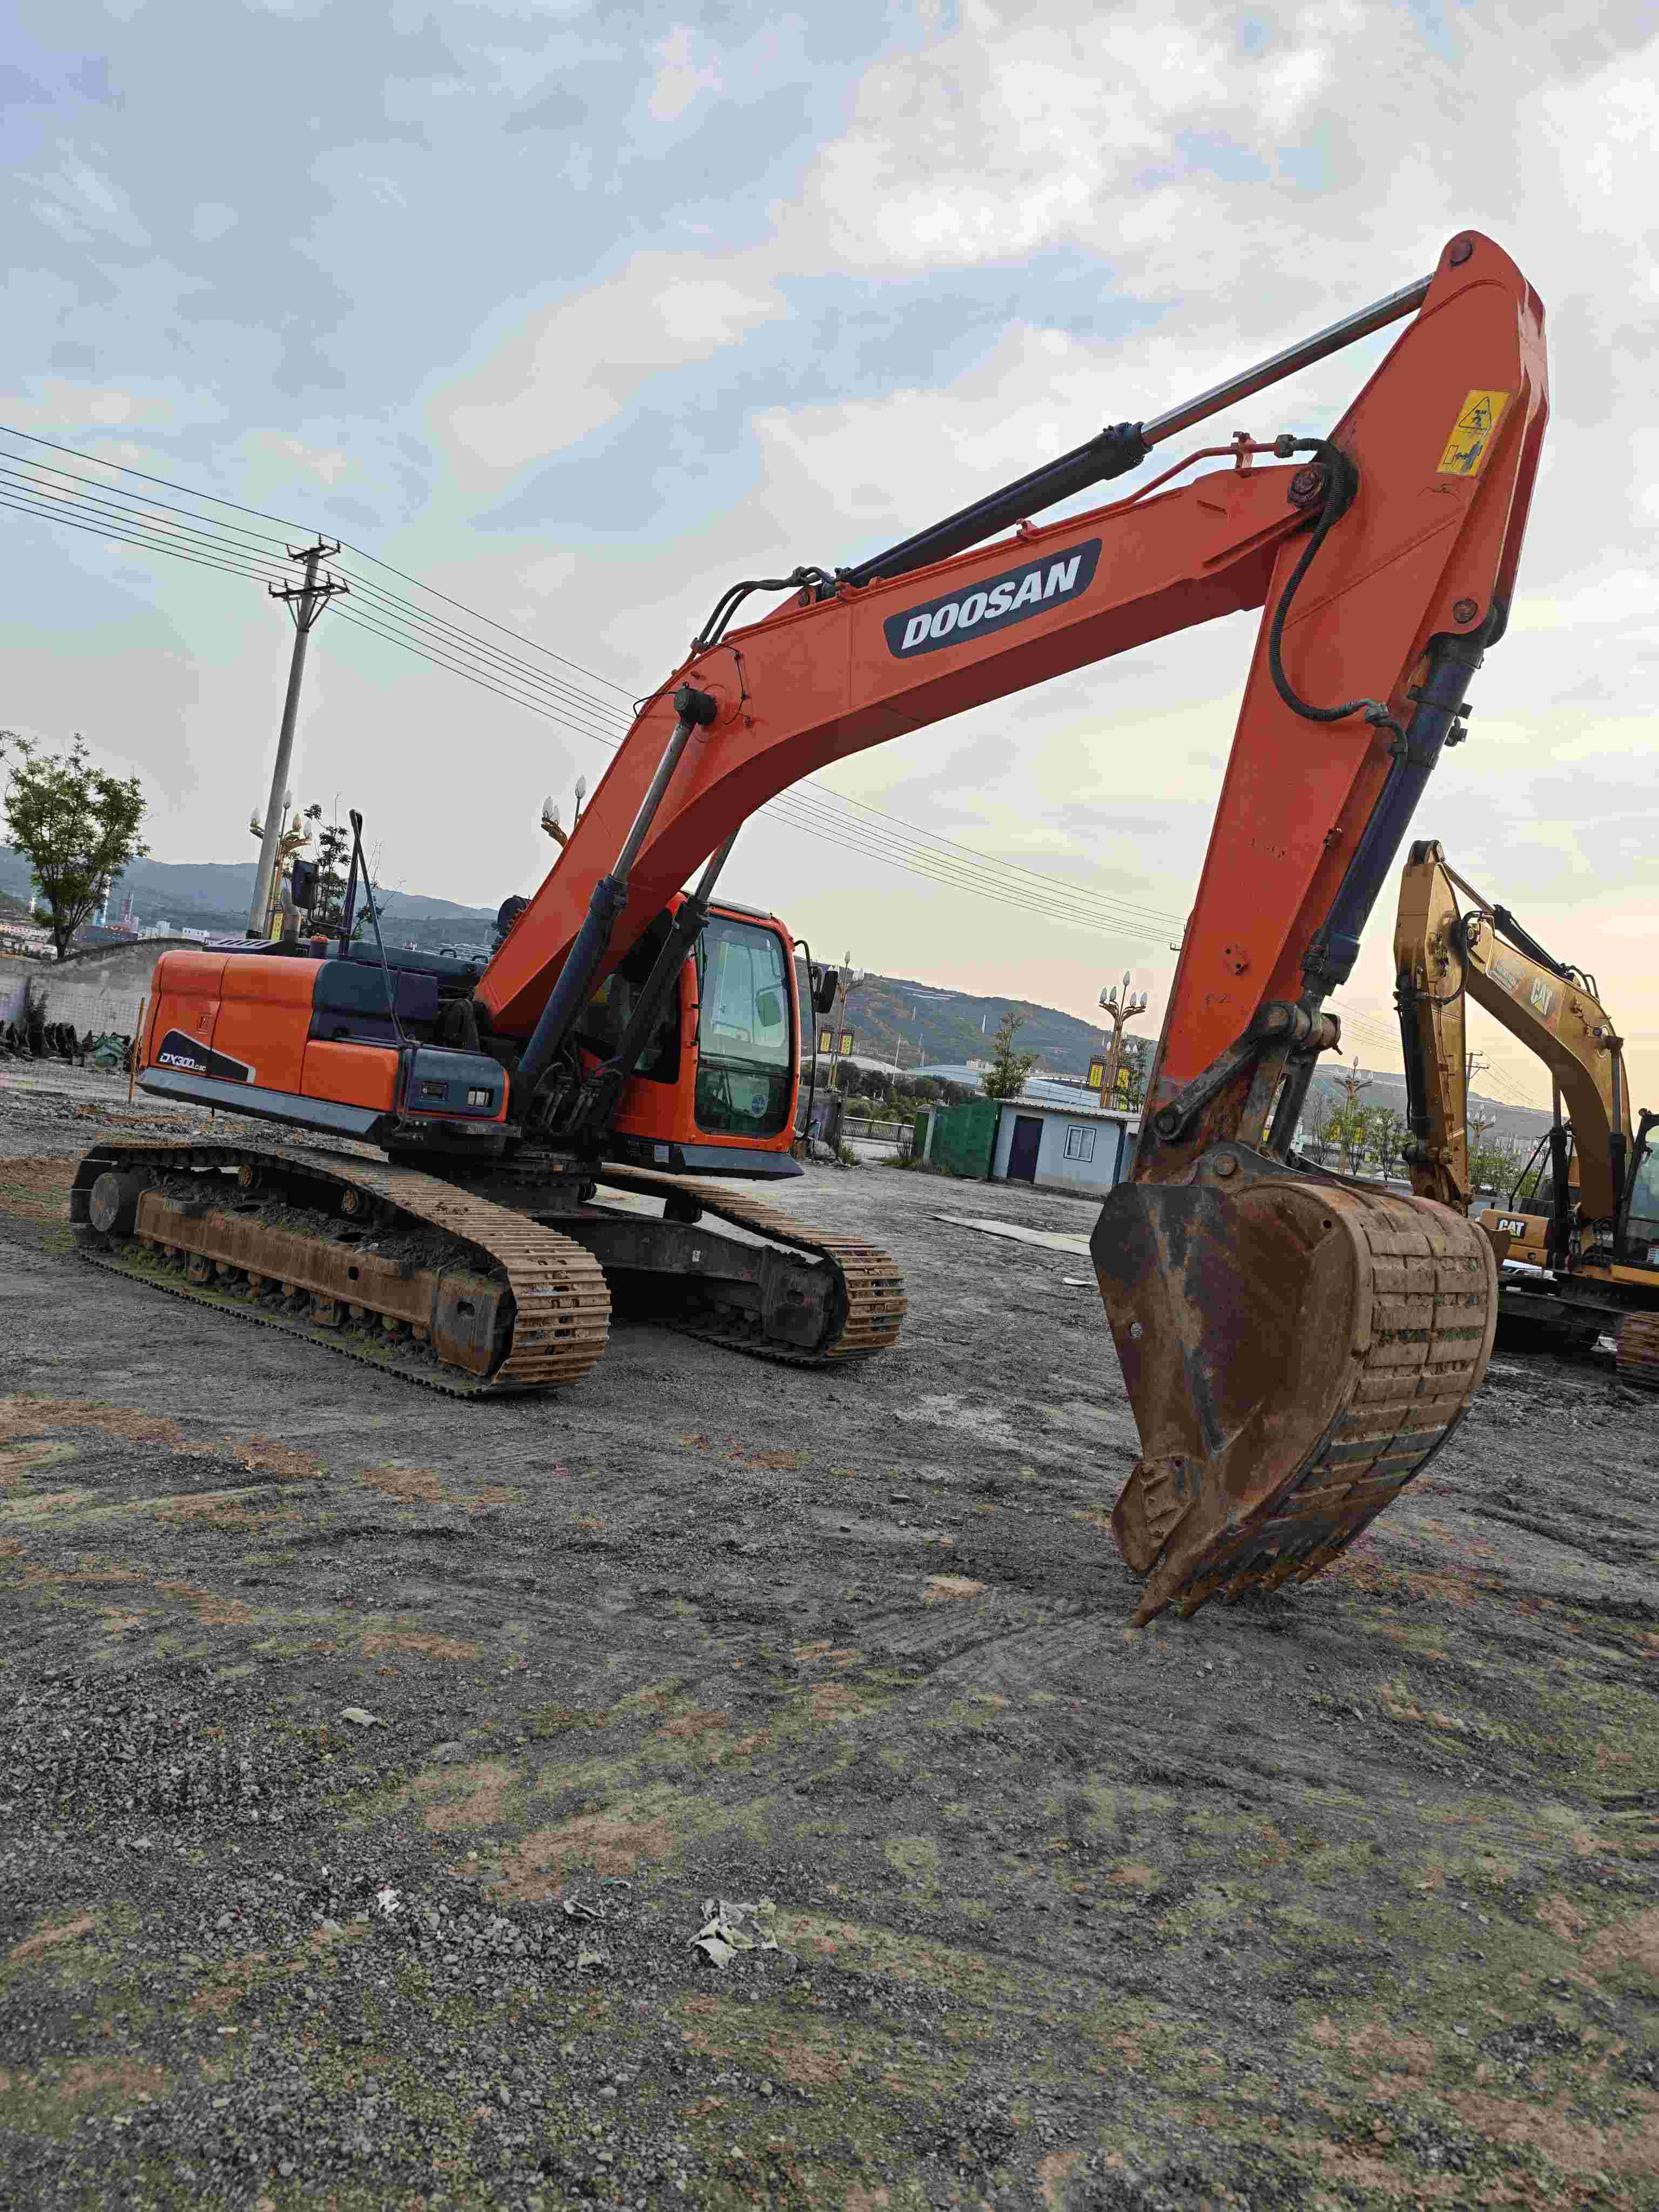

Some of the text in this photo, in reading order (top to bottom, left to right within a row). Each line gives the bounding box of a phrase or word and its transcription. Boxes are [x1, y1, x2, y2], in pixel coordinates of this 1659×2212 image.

[901, 555, 1082, 650] DOOSAN
[1531, 977, 1552, 1015] CAT
[1499, 1219, 1525, 1236] CAT
